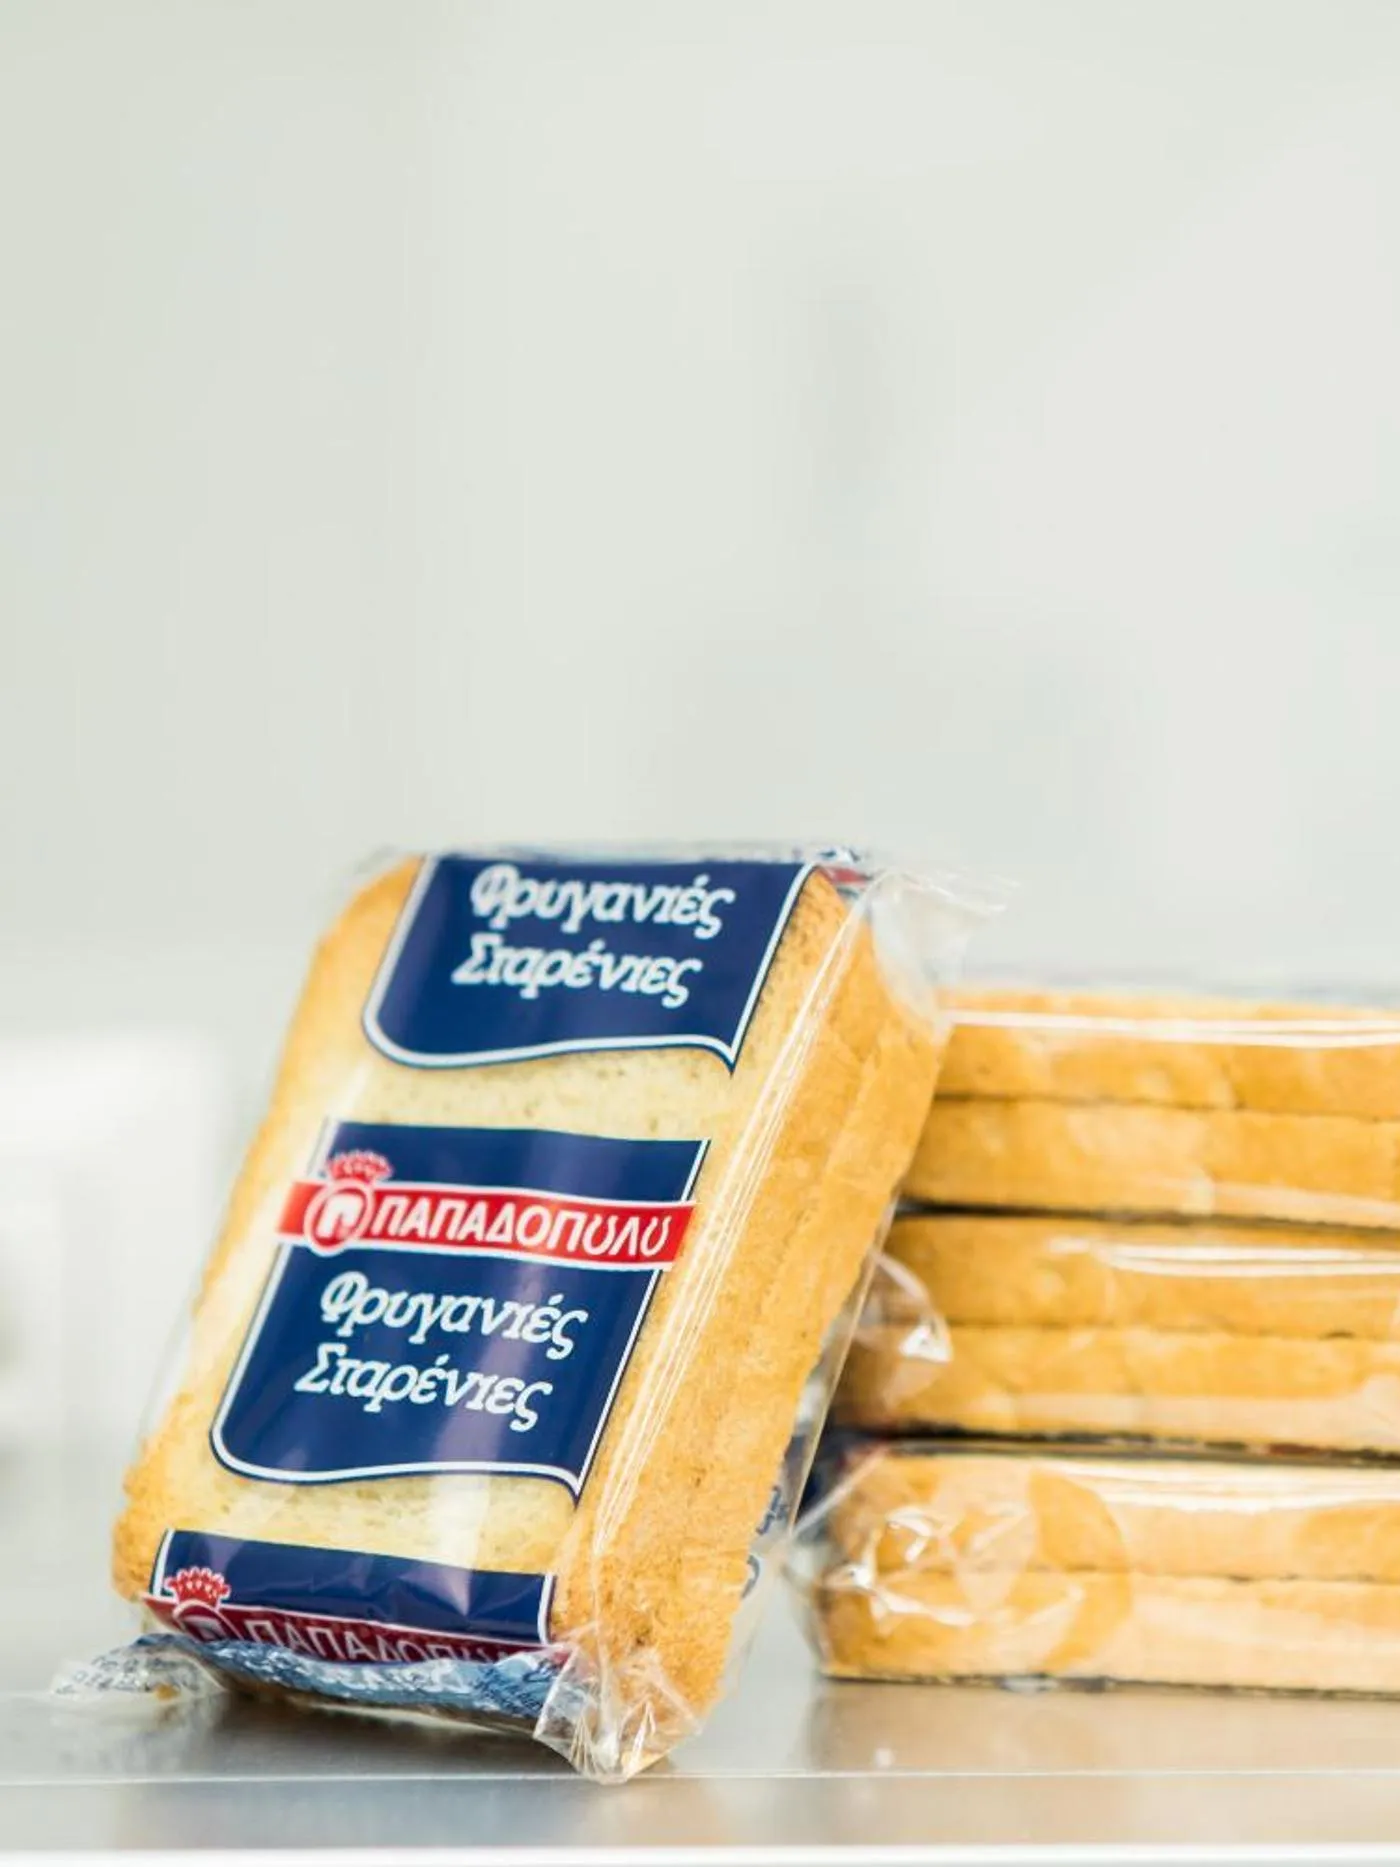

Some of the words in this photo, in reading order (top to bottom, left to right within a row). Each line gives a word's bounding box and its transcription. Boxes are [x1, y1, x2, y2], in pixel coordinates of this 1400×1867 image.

[470, 864, 735, 939] Φρυγανιές
[452, 933, 703, 1008] Σταρένιες
[320, 1271, 588, 1360] Φρυγανιές
[294, 1343, 553, 1432] Σταρένιες
